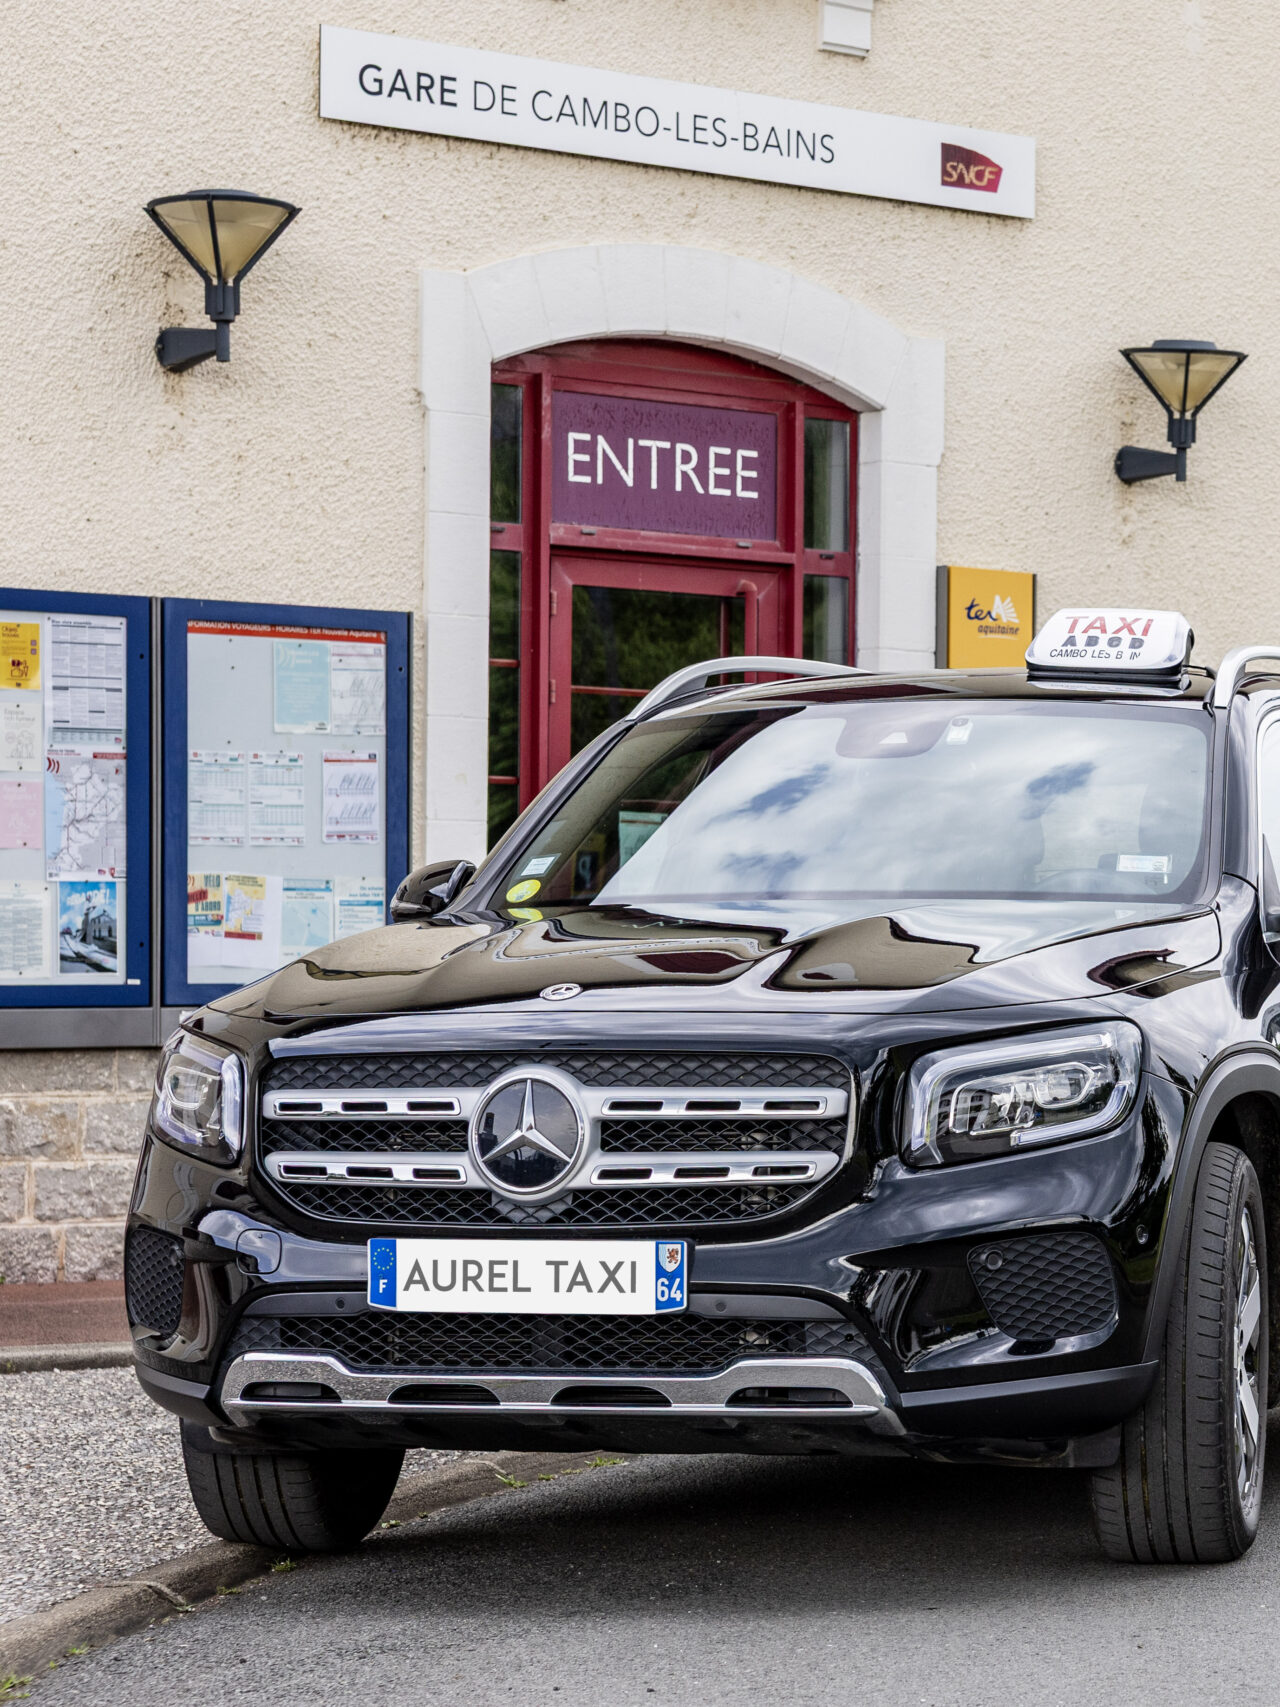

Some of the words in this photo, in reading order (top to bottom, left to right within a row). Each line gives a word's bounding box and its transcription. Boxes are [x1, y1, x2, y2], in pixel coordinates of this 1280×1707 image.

[358, 63, 458, 107] GARE
[473, 80, 518, 117] DE
[531, 90, 835, 164] CAMBO-LES-BAINS
[943, 161, 998, 187] SNCF
[568, 432, 759, 499] ENTREE
[977, 624, 1020, 636] aquitaine
[1066, 616, 1154, 637] TAXI
[1049, 649, 1087, 658] CAMBO
[1091, 650, 1111, 659] LES
[379, 1279, 388, 1294] F
[403, 1258, 532, 1293] AUREL
[545, 1260, 637, 1294] TAXI
[656, 1277, 682, 1303] 64
